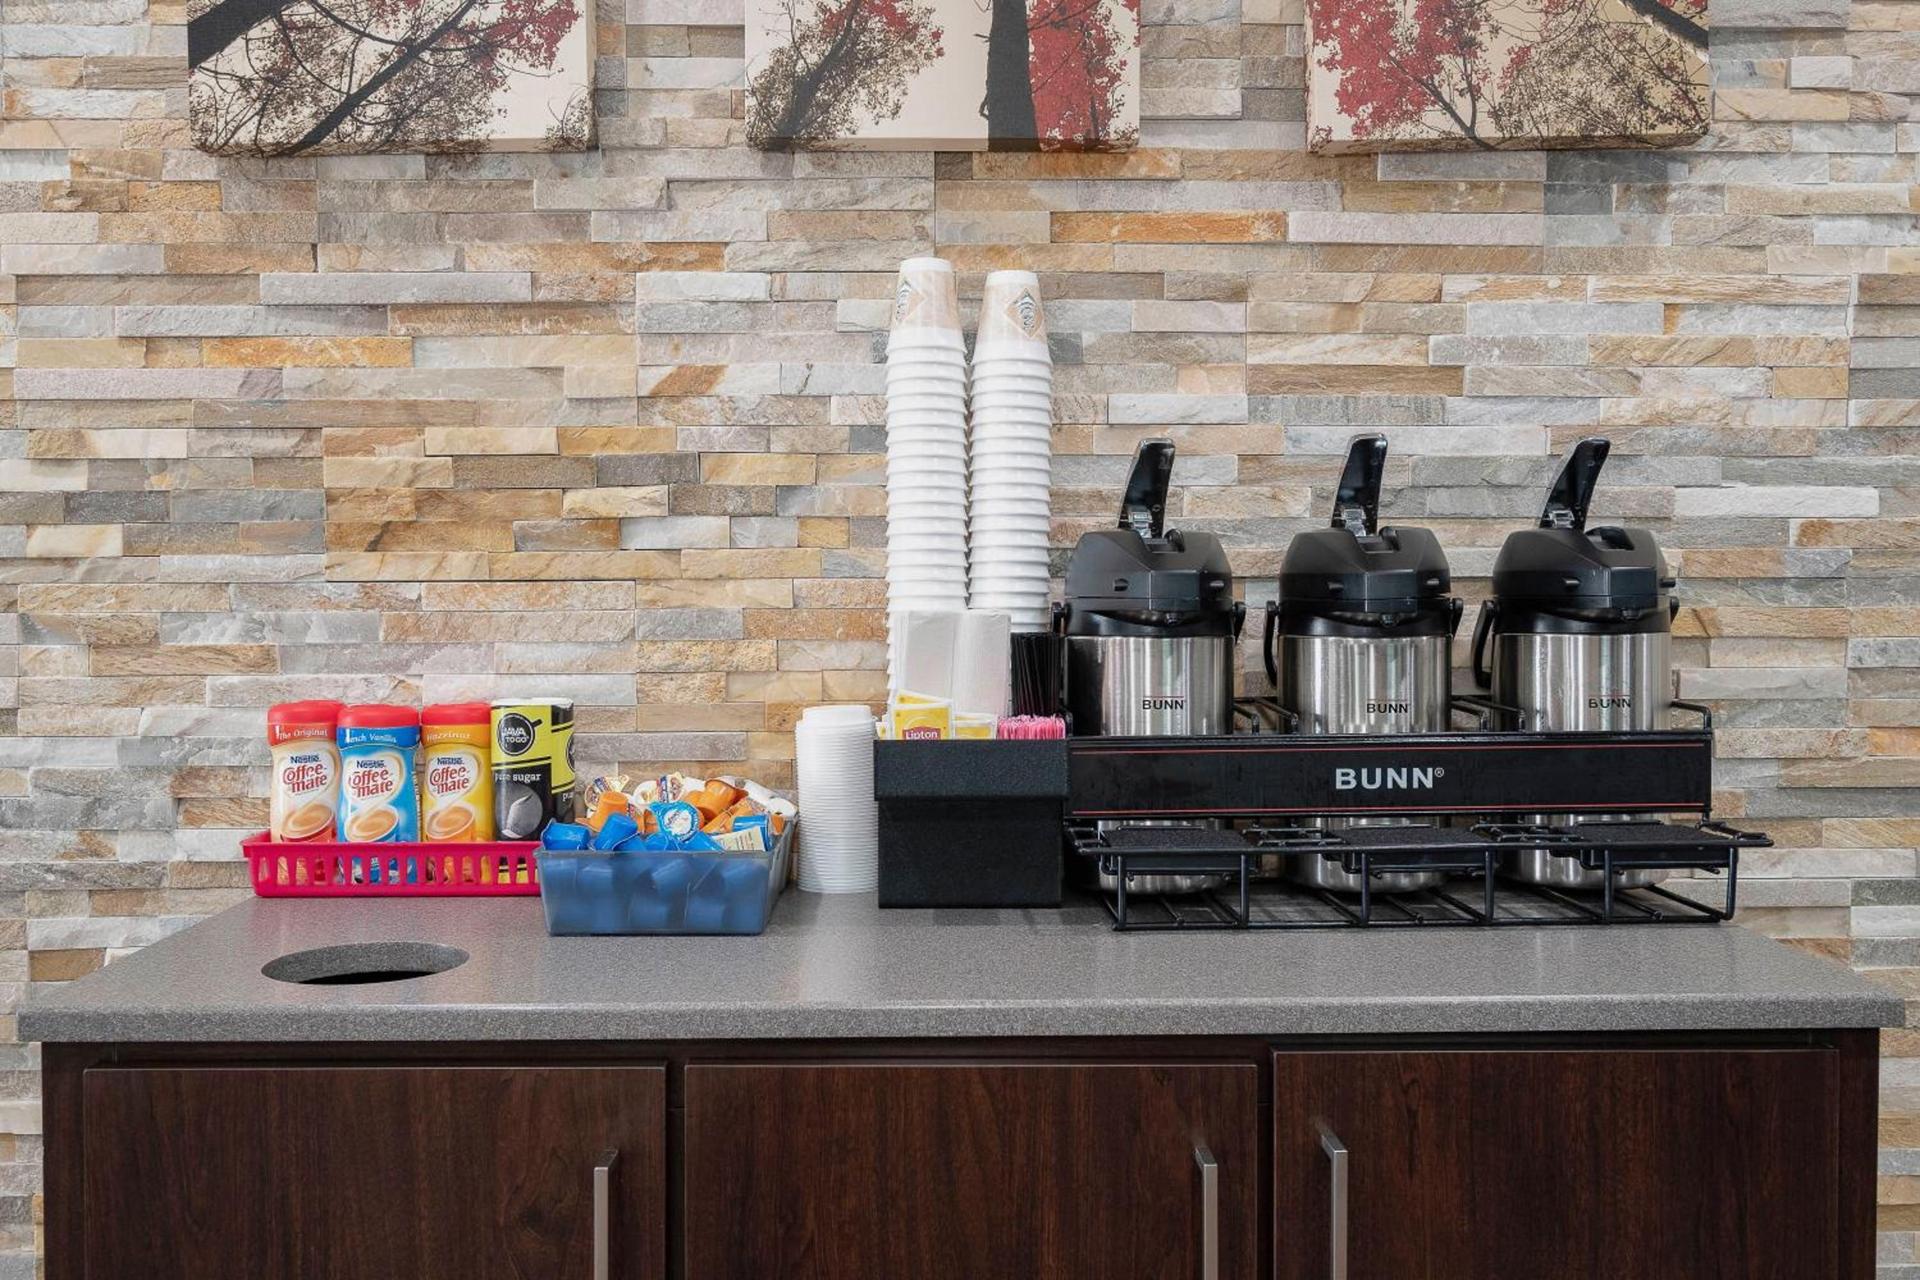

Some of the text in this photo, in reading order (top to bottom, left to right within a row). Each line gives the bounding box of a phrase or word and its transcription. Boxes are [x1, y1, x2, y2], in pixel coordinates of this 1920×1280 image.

[1142, 699, 1184, 710] BUNN
[1366, 702, 1409, 714] BUNN
[1588, 698, 1631, 709] BUNN
[291, 774, 328, 793] mate
[512, 773, 541, 784] sugar
[356, 780, 393, 798] mate
[437, 777, 469, 795] mate
